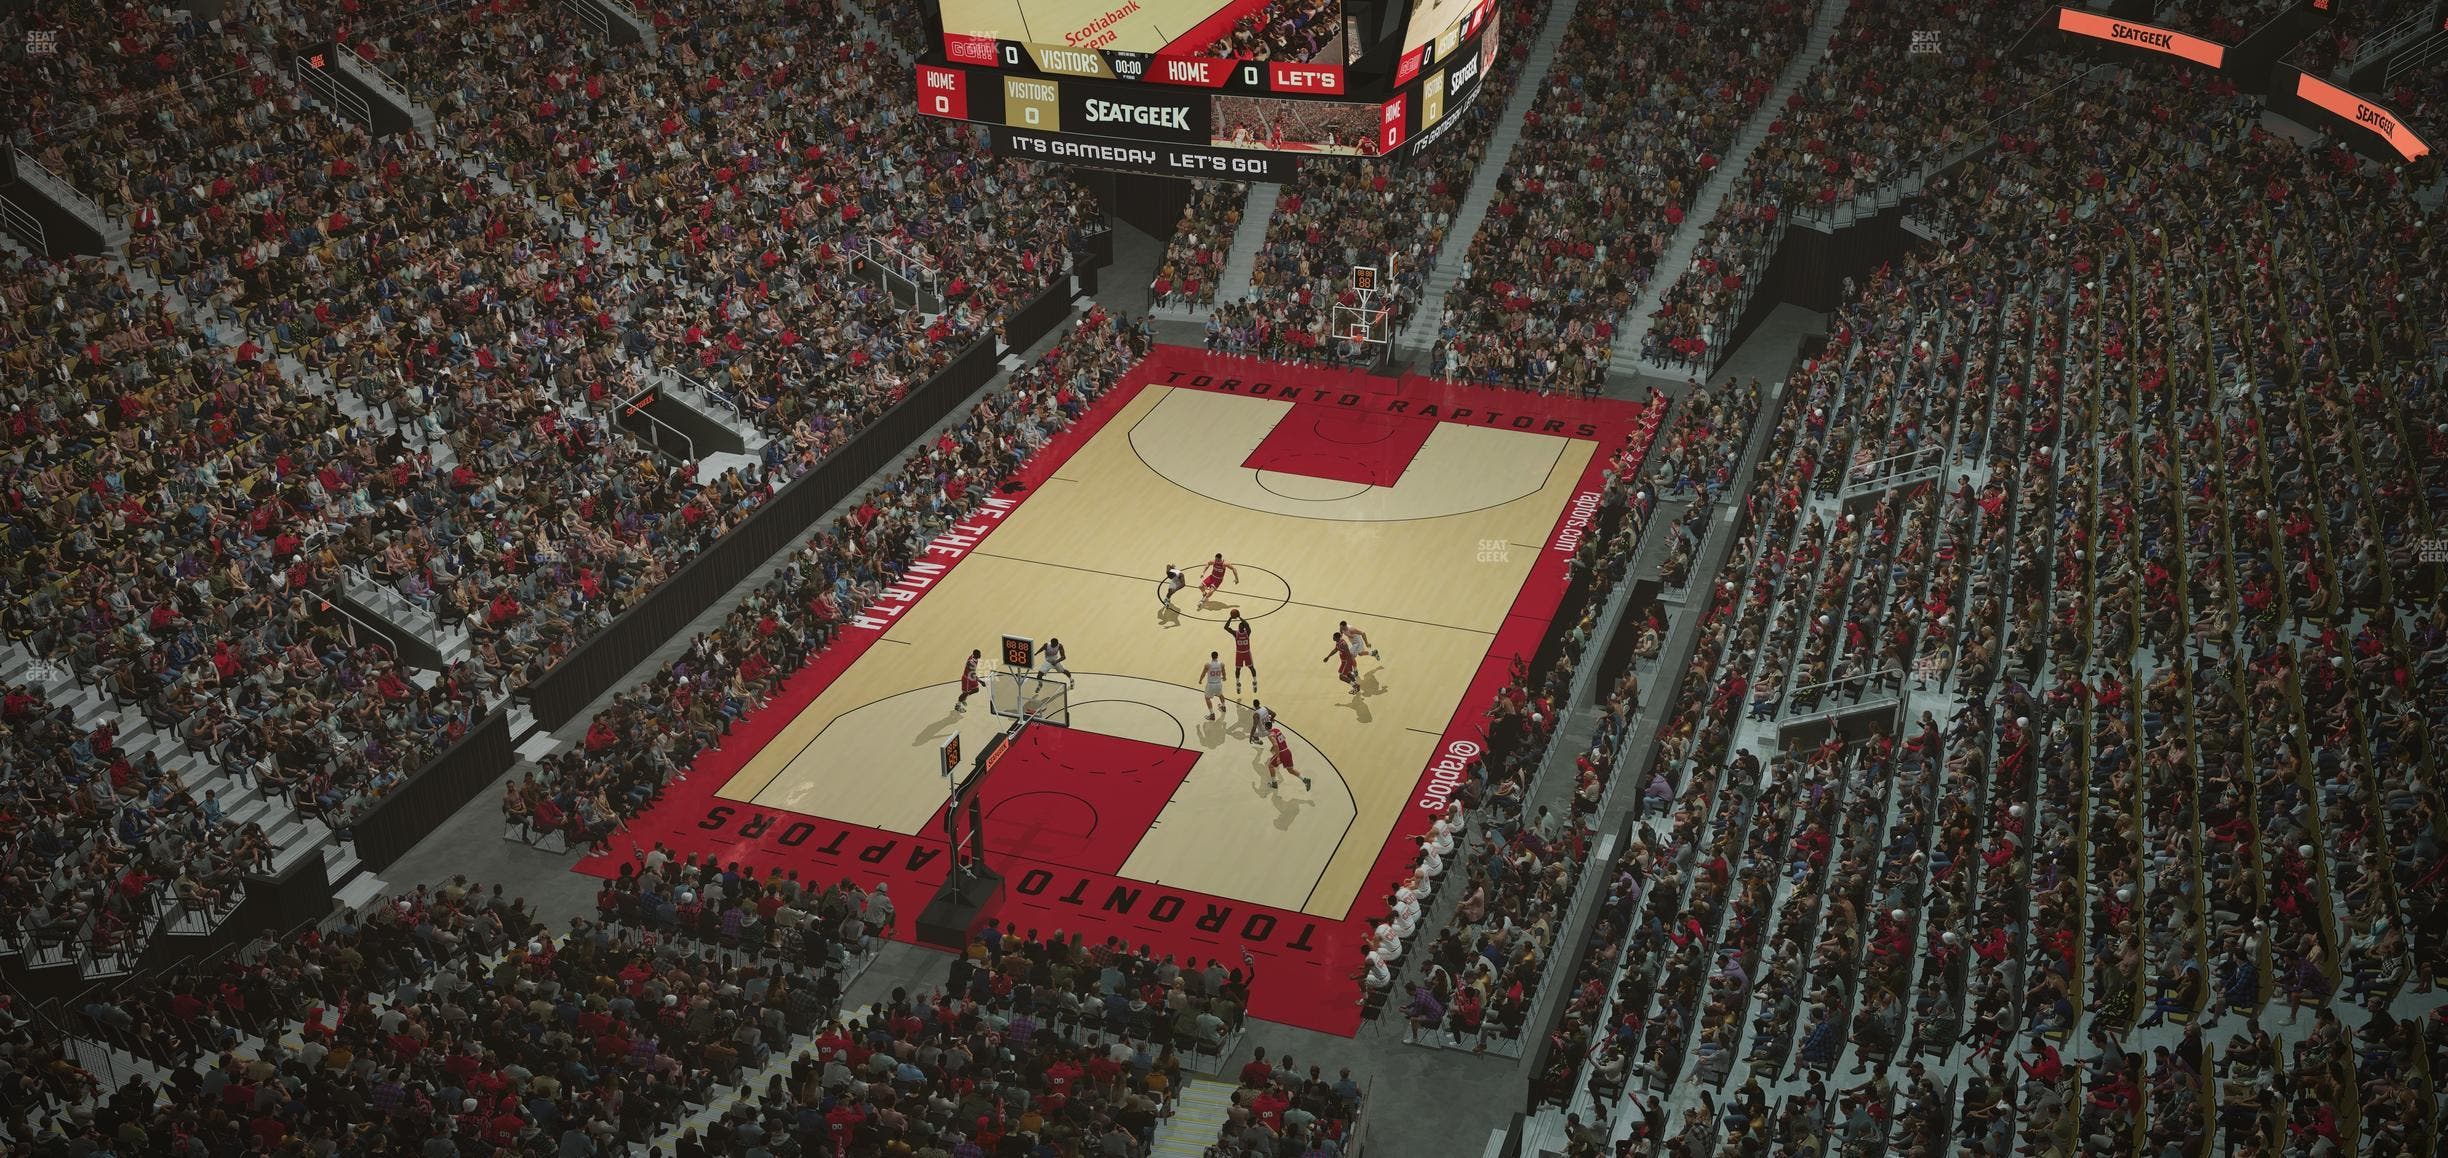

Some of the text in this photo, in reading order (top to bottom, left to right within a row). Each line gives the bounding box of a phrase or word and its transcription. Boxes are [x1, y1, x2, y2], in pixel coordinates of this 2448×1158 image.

[1065, 0, 1141, 47] Scotiabank
[1074, 30, 1118, 49] rena
[2112, 23, 2173, 49] SEATGEEK
[1006, 46, 1019, 64] 0
[1040, 49, 1099, 74] VISITORS
[1115, 60, 1142, 75] 00:00
[1168, 60, 1210, 83] HOME
[1244, 66, 1258, 85] 0
[1278, 71, 1336, 88] LET'S
[1451, 51, 1479, 96] SEATGEEK
[927, 71, 955, 90] HOME
[1008, 81, 1055, 102] VISITORS
[935, 95, 949, 113] 0
[1024, 107, 1040, 125] 0
[1085, 99, 1190, 131] SEATGEEK
[1385, 100, 1401, 124] HOME
[2356, 104, 2396, 140] SEATGEEK
[1388, 127, 1396, 147] 0
[1012, 136, 1268, 174] IT'S GAMEDAY LET'S GO!
[1165, 371, 1599, 437] TORONTO RAPTORS
[1554, 491, 1601, 552] raptors.com
[850, 497, 1017, 631] WE THE NORTH
[1009, 649, 1027, 665] 88
[1419, 740, 1480, 811] @raptors
[697, 806, 1316, 952] TORONTO APTORS
